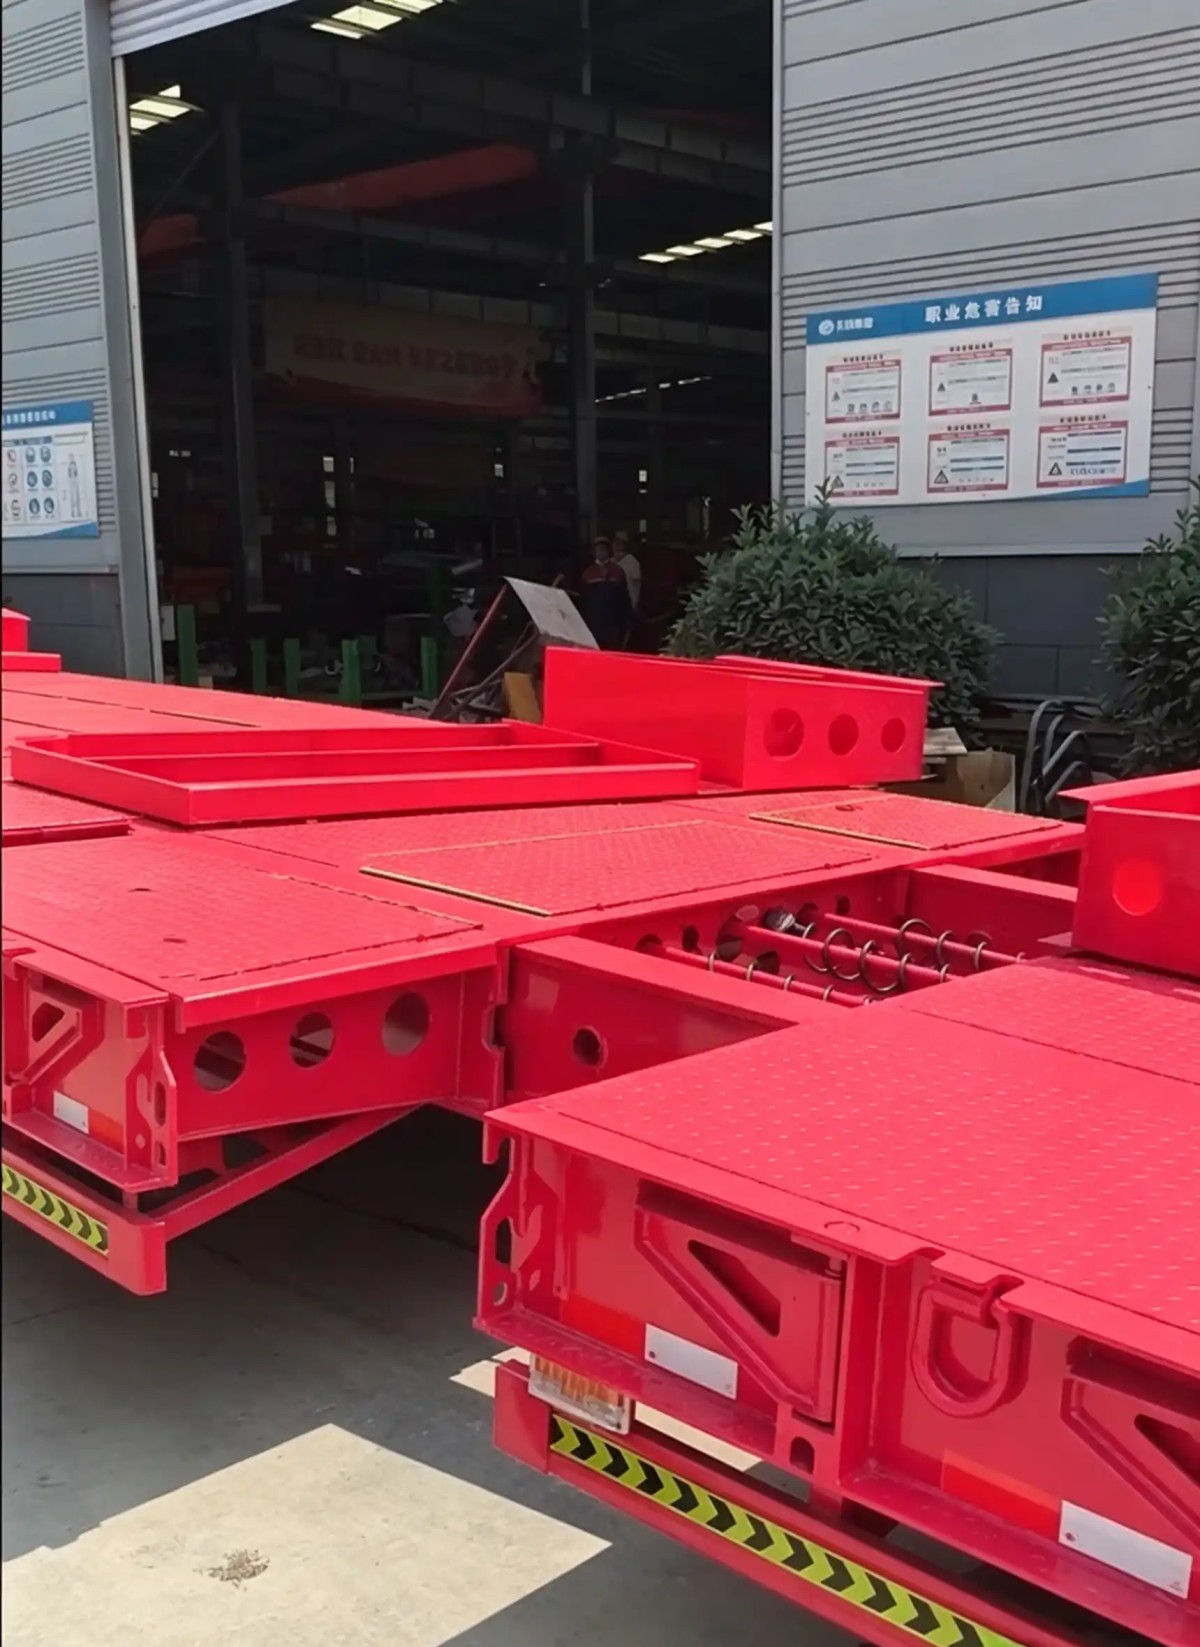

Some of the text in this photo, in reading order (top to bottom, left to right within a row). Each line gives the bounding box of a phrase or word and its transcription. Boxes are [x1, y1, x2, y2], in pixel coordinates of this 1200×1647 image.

[925, 294, 1043, 323] 职业危害告知
